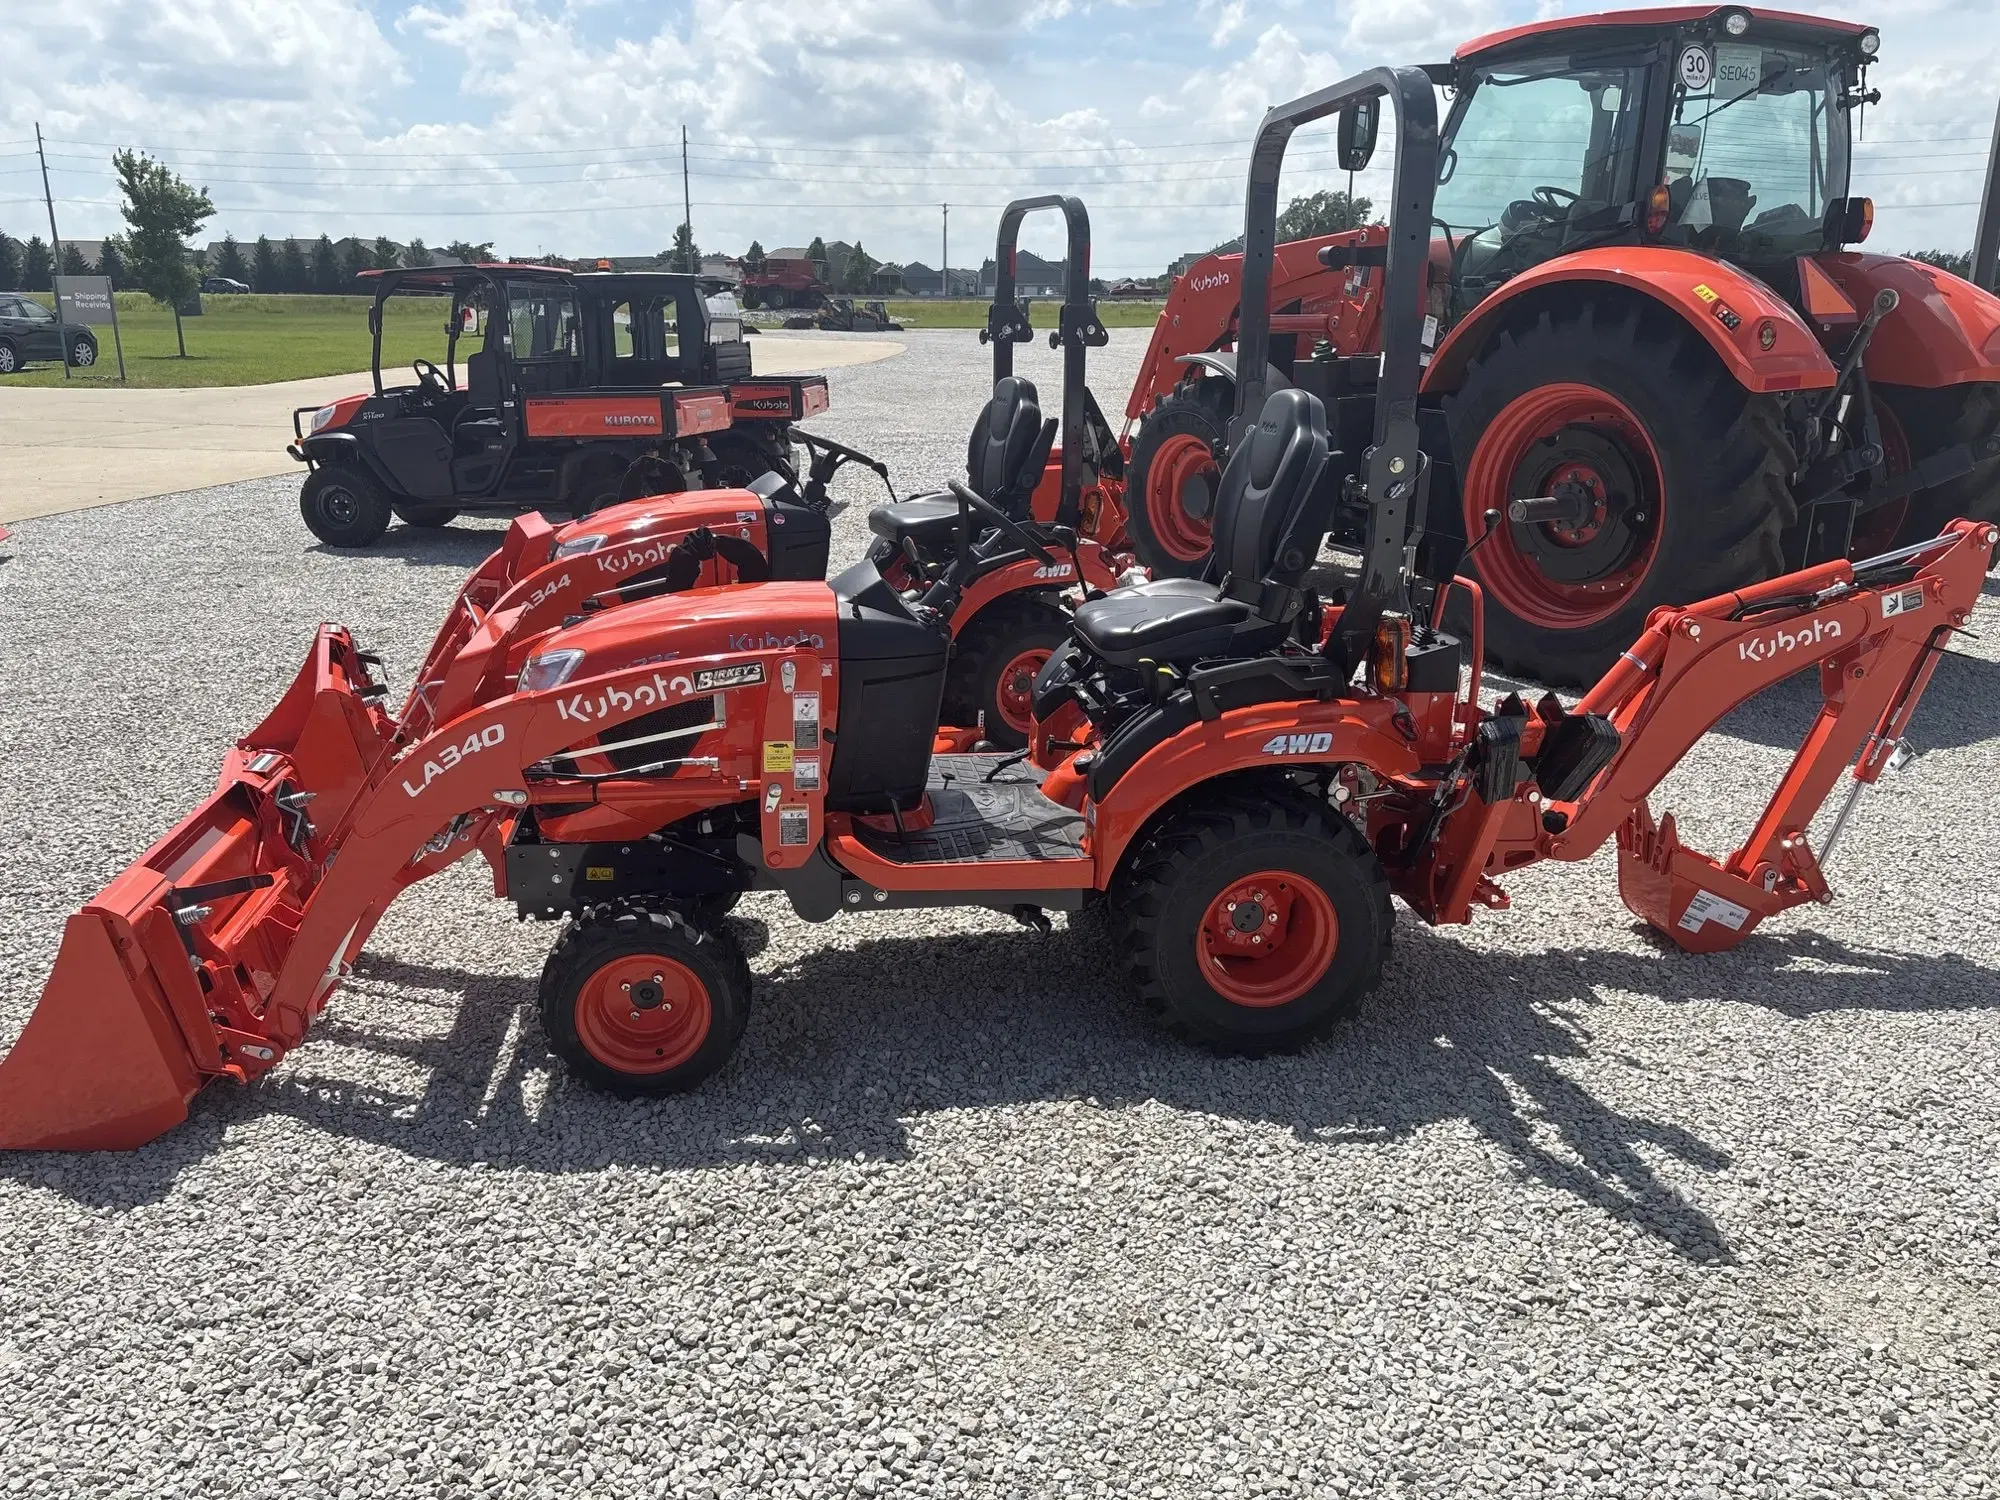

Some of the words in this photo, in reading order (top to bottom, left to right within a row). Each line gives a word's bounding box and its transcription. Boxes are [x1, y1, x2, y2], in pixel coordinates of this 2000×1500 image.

[1686, 55, 1704, 73] 30
[1720, 65, 1756, 81] SE045
[1190, 271, 1229, 292] Kubota
[74, 291, 109, 301] Shipping/
[75, 300, 111, 310] Receiving
[753, 400, 789, 410] Kubota
[604, 415, 656, 426] KUBOTA
[1033, 564, 1072, 579] 4WD
[1738, 619, 1842, 662] Kubota
[696, 664, 762, 690] BIRKEY'S
[556, 673, 694, 723] Kubota
[1261, 732, 1333, 756] 4WD
[402, 723, 505, 798] LA340
